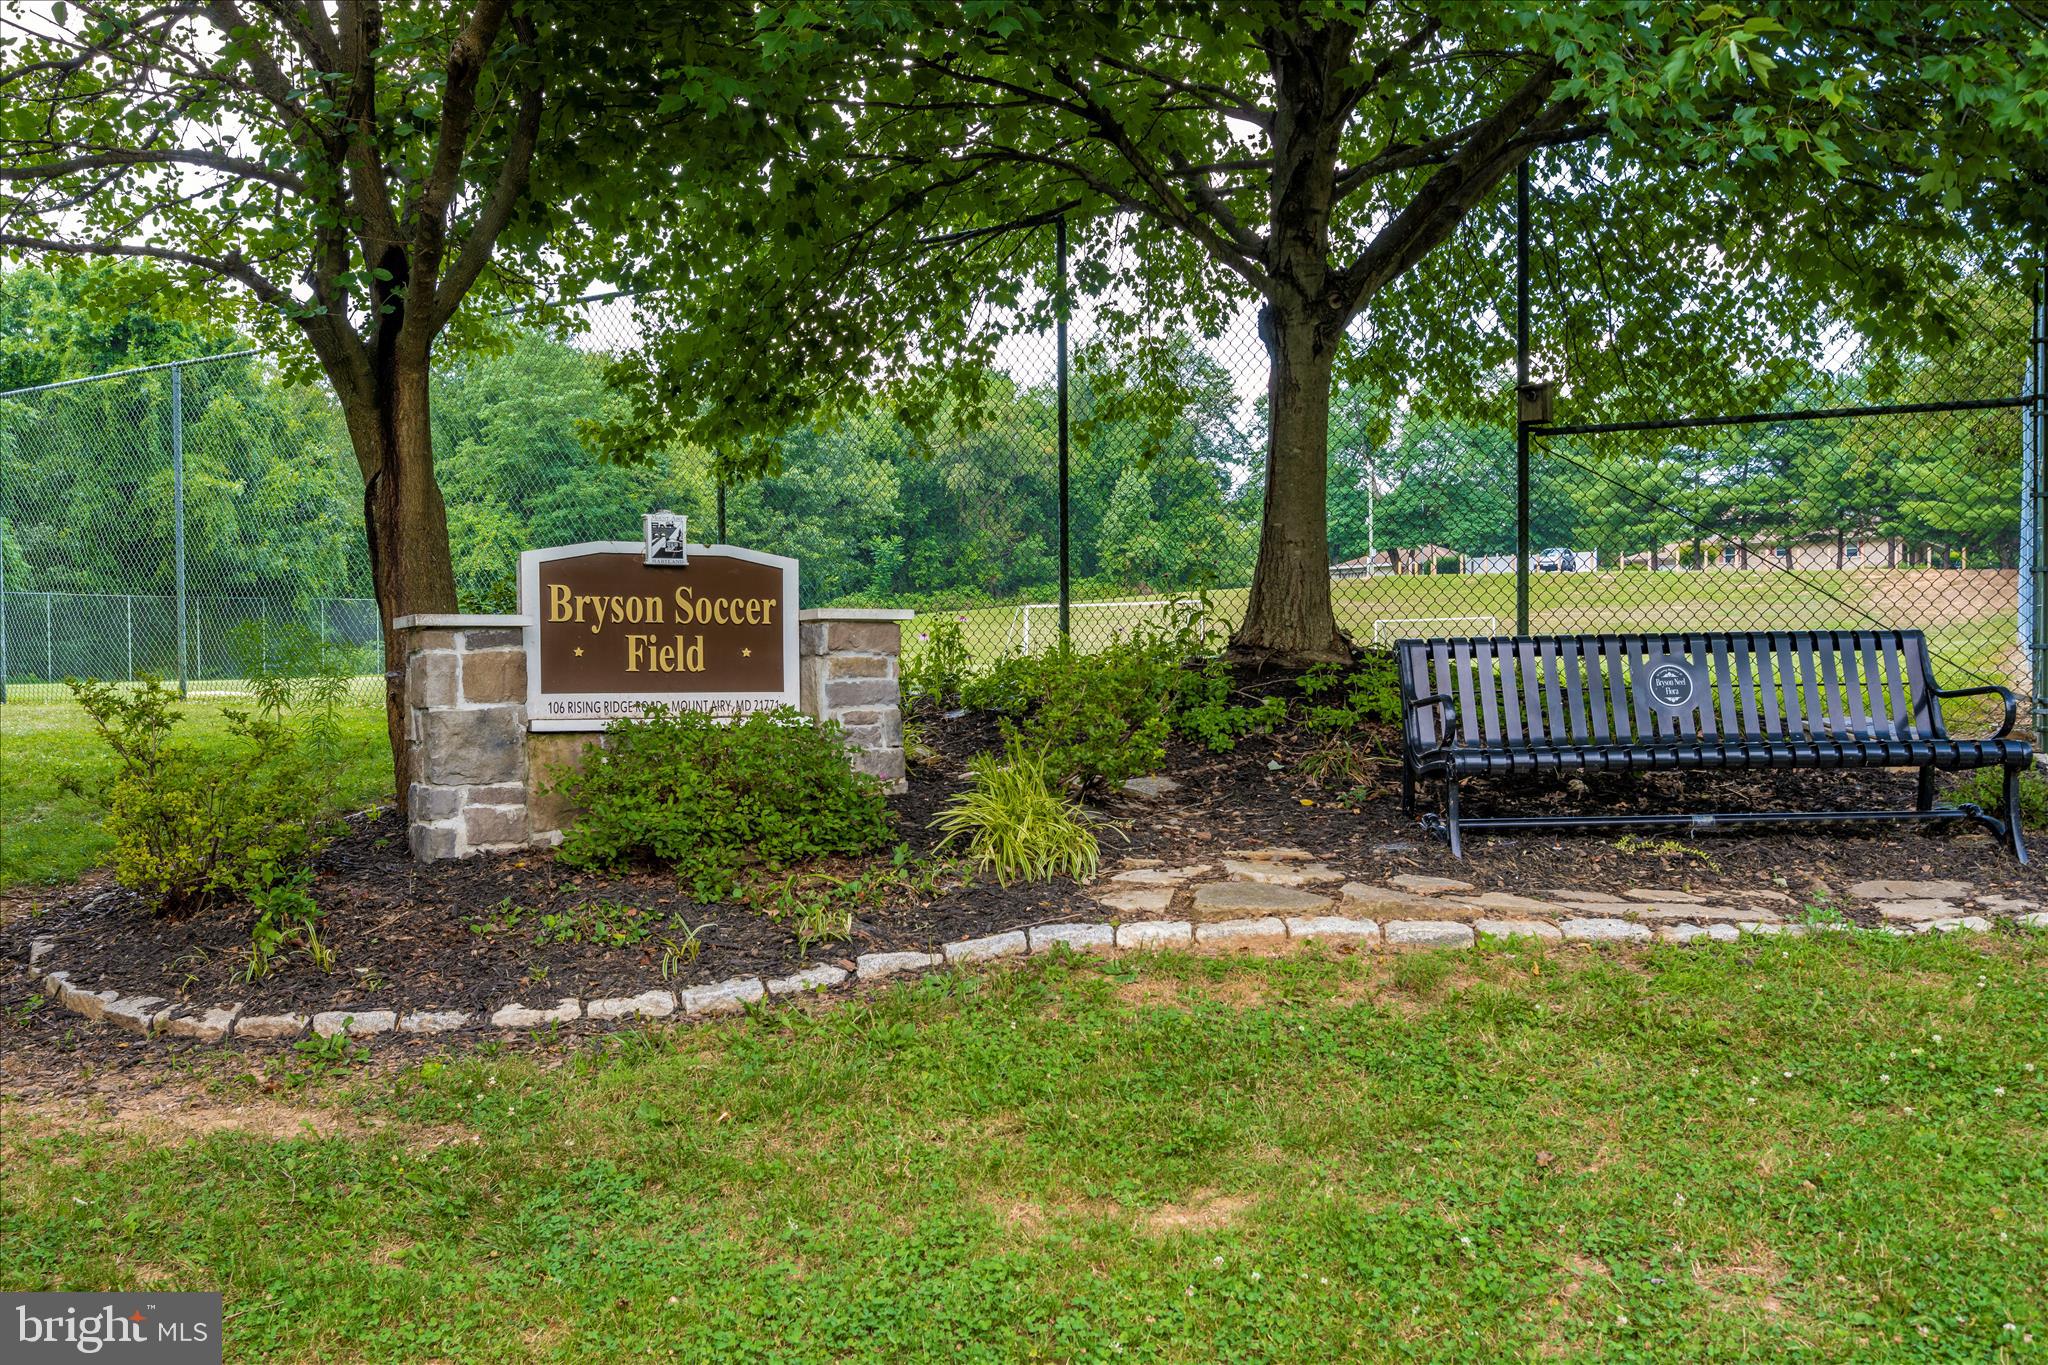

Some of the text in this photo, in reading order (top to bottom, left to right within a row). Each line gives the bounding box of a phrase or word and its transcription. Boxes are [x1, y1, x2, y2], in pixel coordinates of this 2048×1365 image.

[547, 584, 777, 634] Bryson Soccer
[625, 634, 706, 673] Field
[548, 701, 565, 714] 106
[567, 701, 600, 714] RISING
[603, 700, 633, 713] RIDGE
[671, 700, 708, 712] MOUNT
[736, 699, 752, 711] MD
[754, 699, 779, 712] 21771
